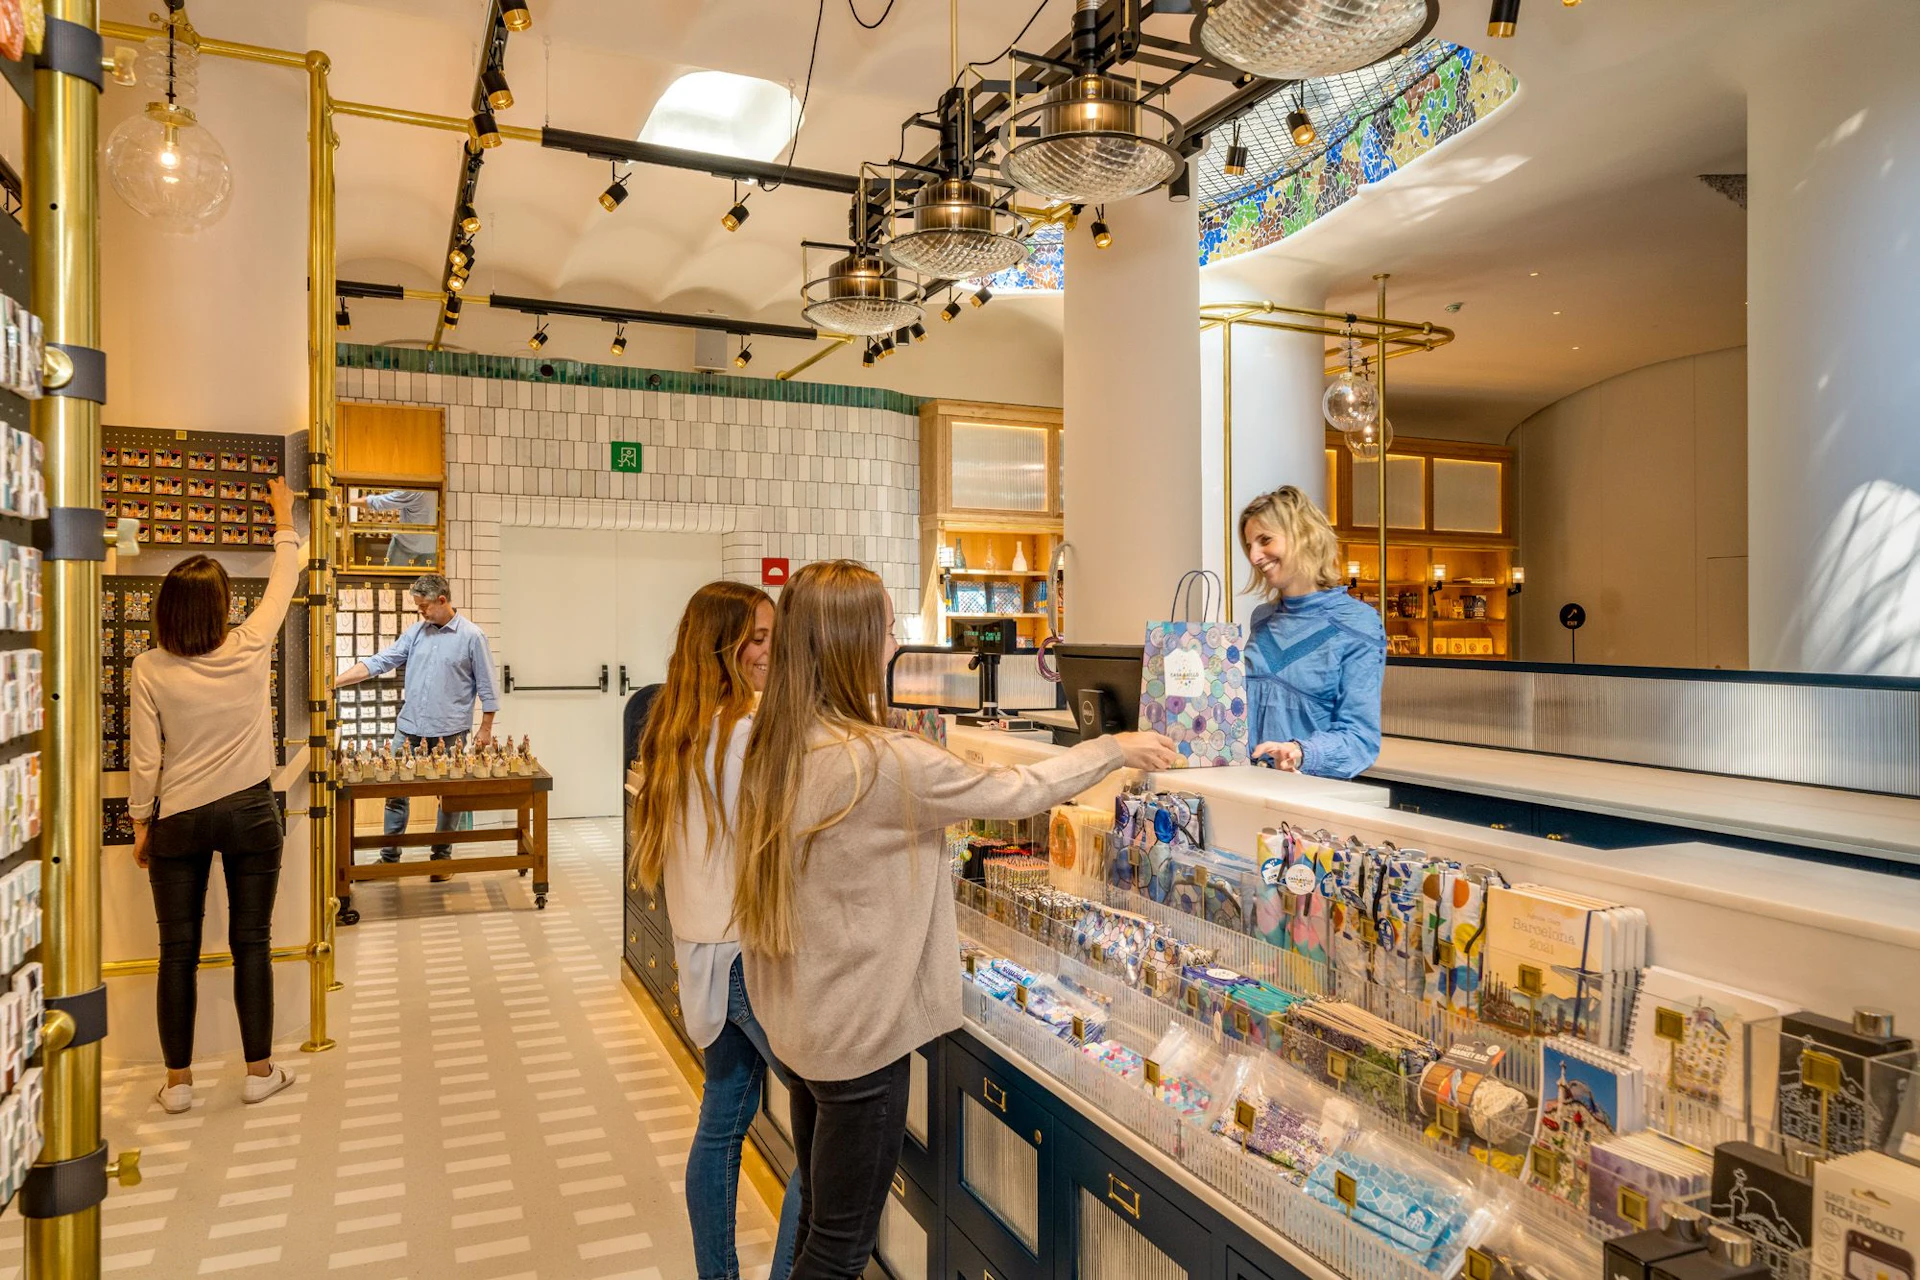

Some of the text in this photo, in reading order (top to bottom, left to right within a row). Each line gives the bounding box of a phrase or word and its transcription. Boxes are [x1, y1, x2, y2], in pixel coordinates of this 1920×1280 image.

[1513, 917, 1576, 946] Barcelona
[1529, 938, 1554, 955] 2021
[1002, 966, 1024, 982] mentos
[1449, 1047, 1476, 1059] MARKET
[1474, 1053, 1490, 1062] BAG
[1824, 1200, 1905, 1243] TECH POCKET
